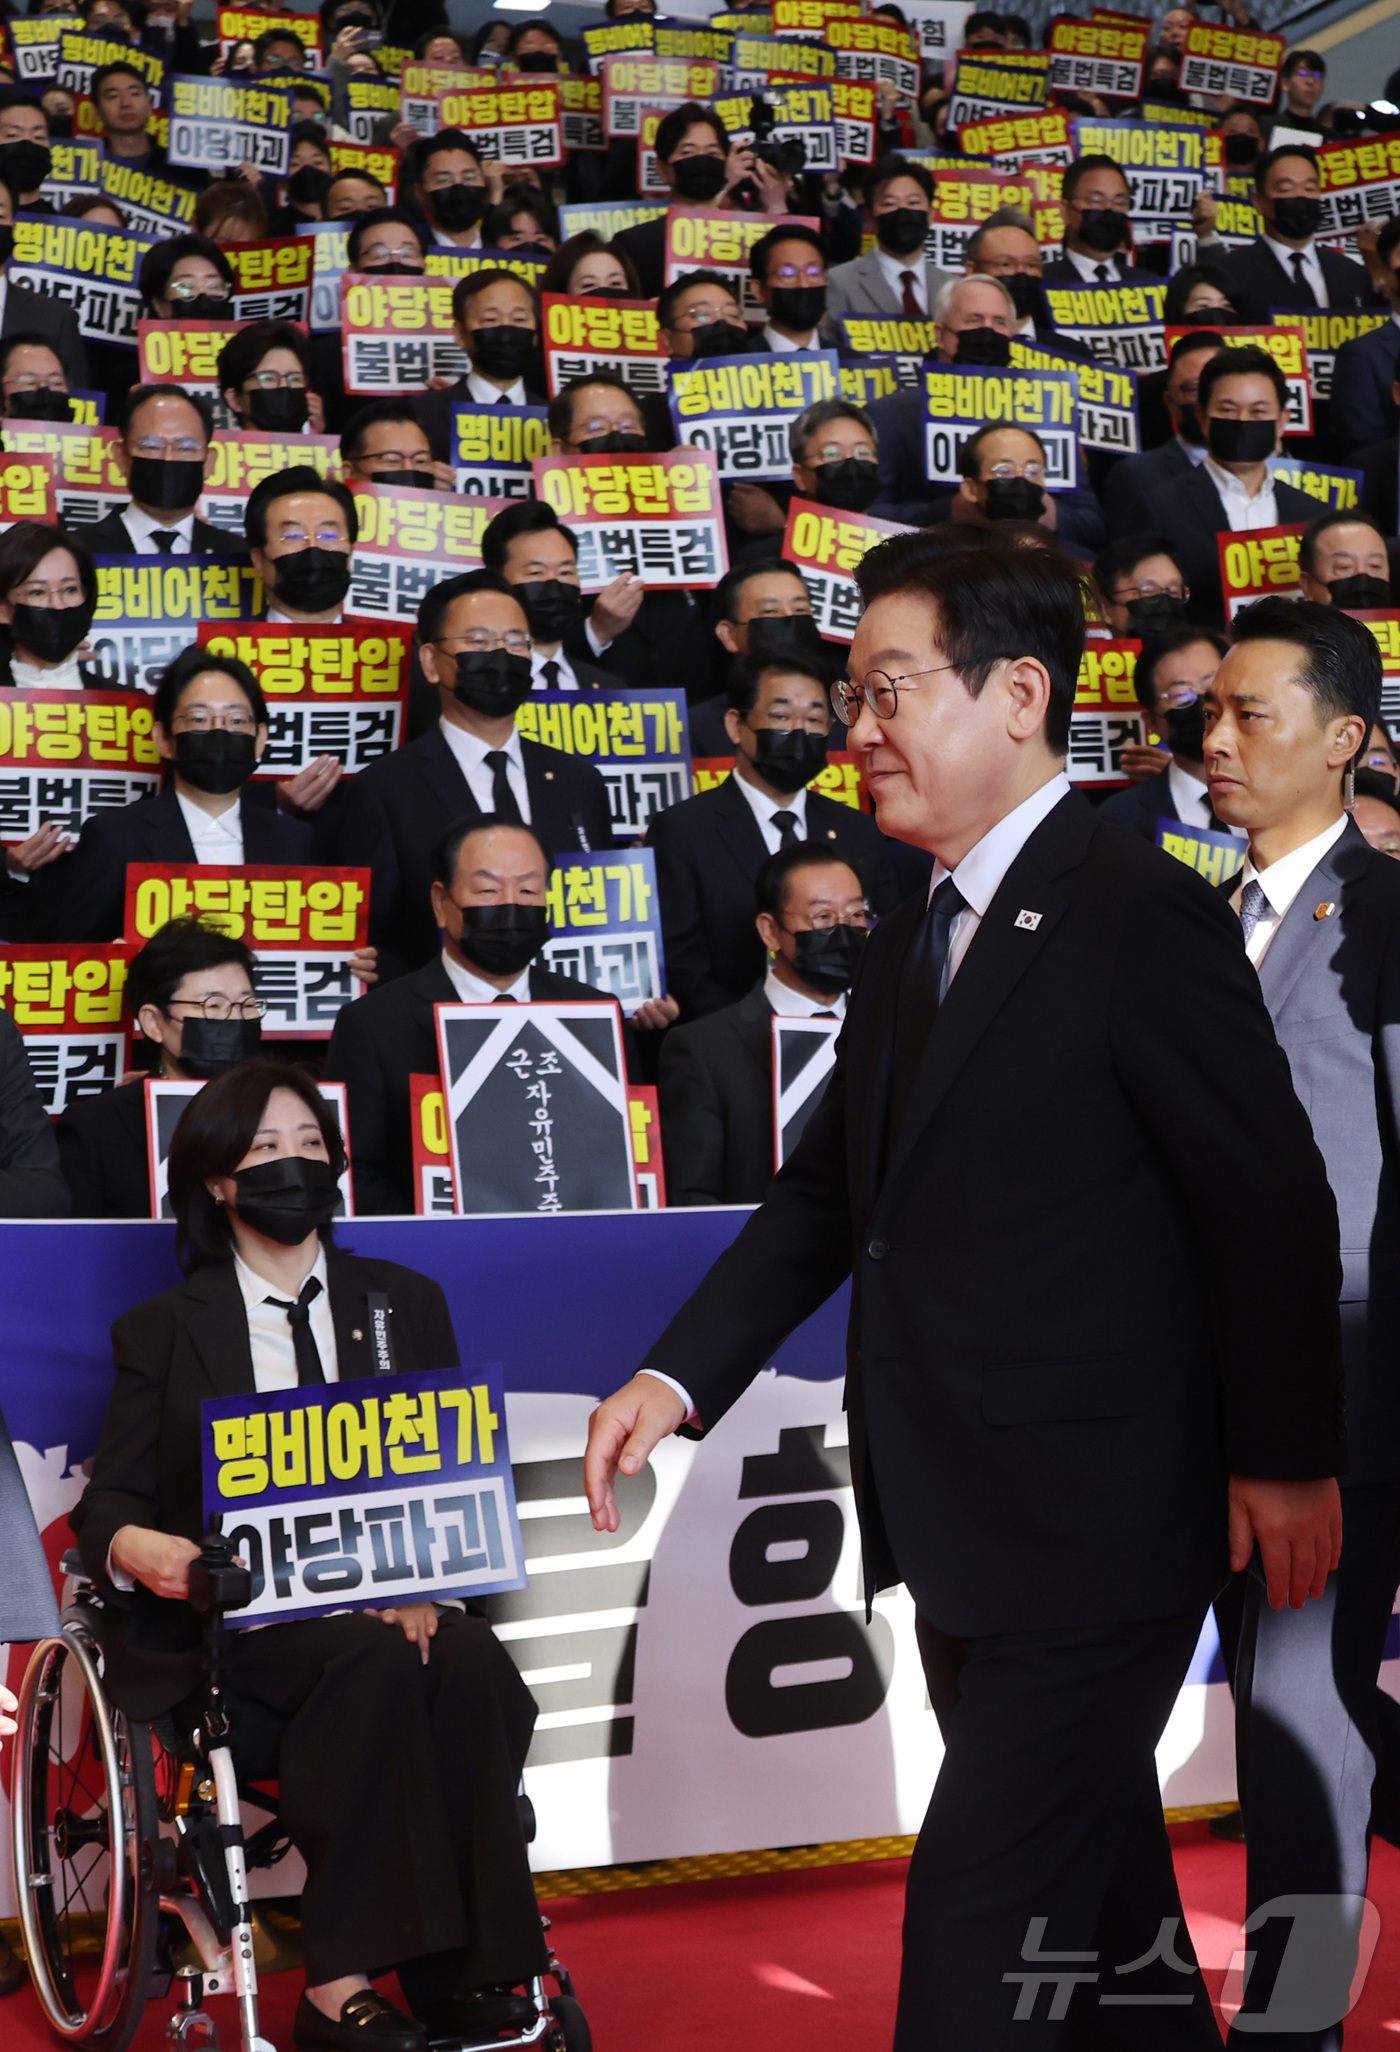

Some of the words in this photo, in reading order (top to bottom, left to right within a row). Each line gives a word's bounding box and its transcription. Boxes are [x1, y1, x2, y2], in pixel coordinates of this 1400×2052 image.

[736, 40, 836, 77] 명비어천가
[1054, 24, 1146, 59] 야당탄압
[1188, 27, 1282, 66] 야당탄압
[610, 62, 717, 96] 야당탄압
[957, 65, 1046, 102] 명비어천가
[1051, 57, 1137, 92] 불법특검
[1186, 60, 1273, 98] 불법특검
[173, 82, 290, 128] 명비어천가
[441, 90, 557, 126] 야당탄압
[177, 126, 283, 168] 야당파괴
[961, 115, 1067, 154] 야당탄압
[1079, 127, 1204, 169] 명비어천가
[13, 222, 153, 281] 명비어천
[671, 360, 837, 417] 명비어천가
[925, 372, 1075, 425] 명비어천가
[541, 462, 714, 517] 야당탄압
[204, 636, 406, 694] 야당탄압
[135, 877, 364, 942] 야당탄압
[0, 958, 129, 1026] 탄압
[505, 1048, 564, 1080] 근조
[373, 1308, 391, 1370] 자유민주주의
[211, 1385, 499, 1498] 명비어천가
[230, 1490, 507, 1601] 야당파괴
